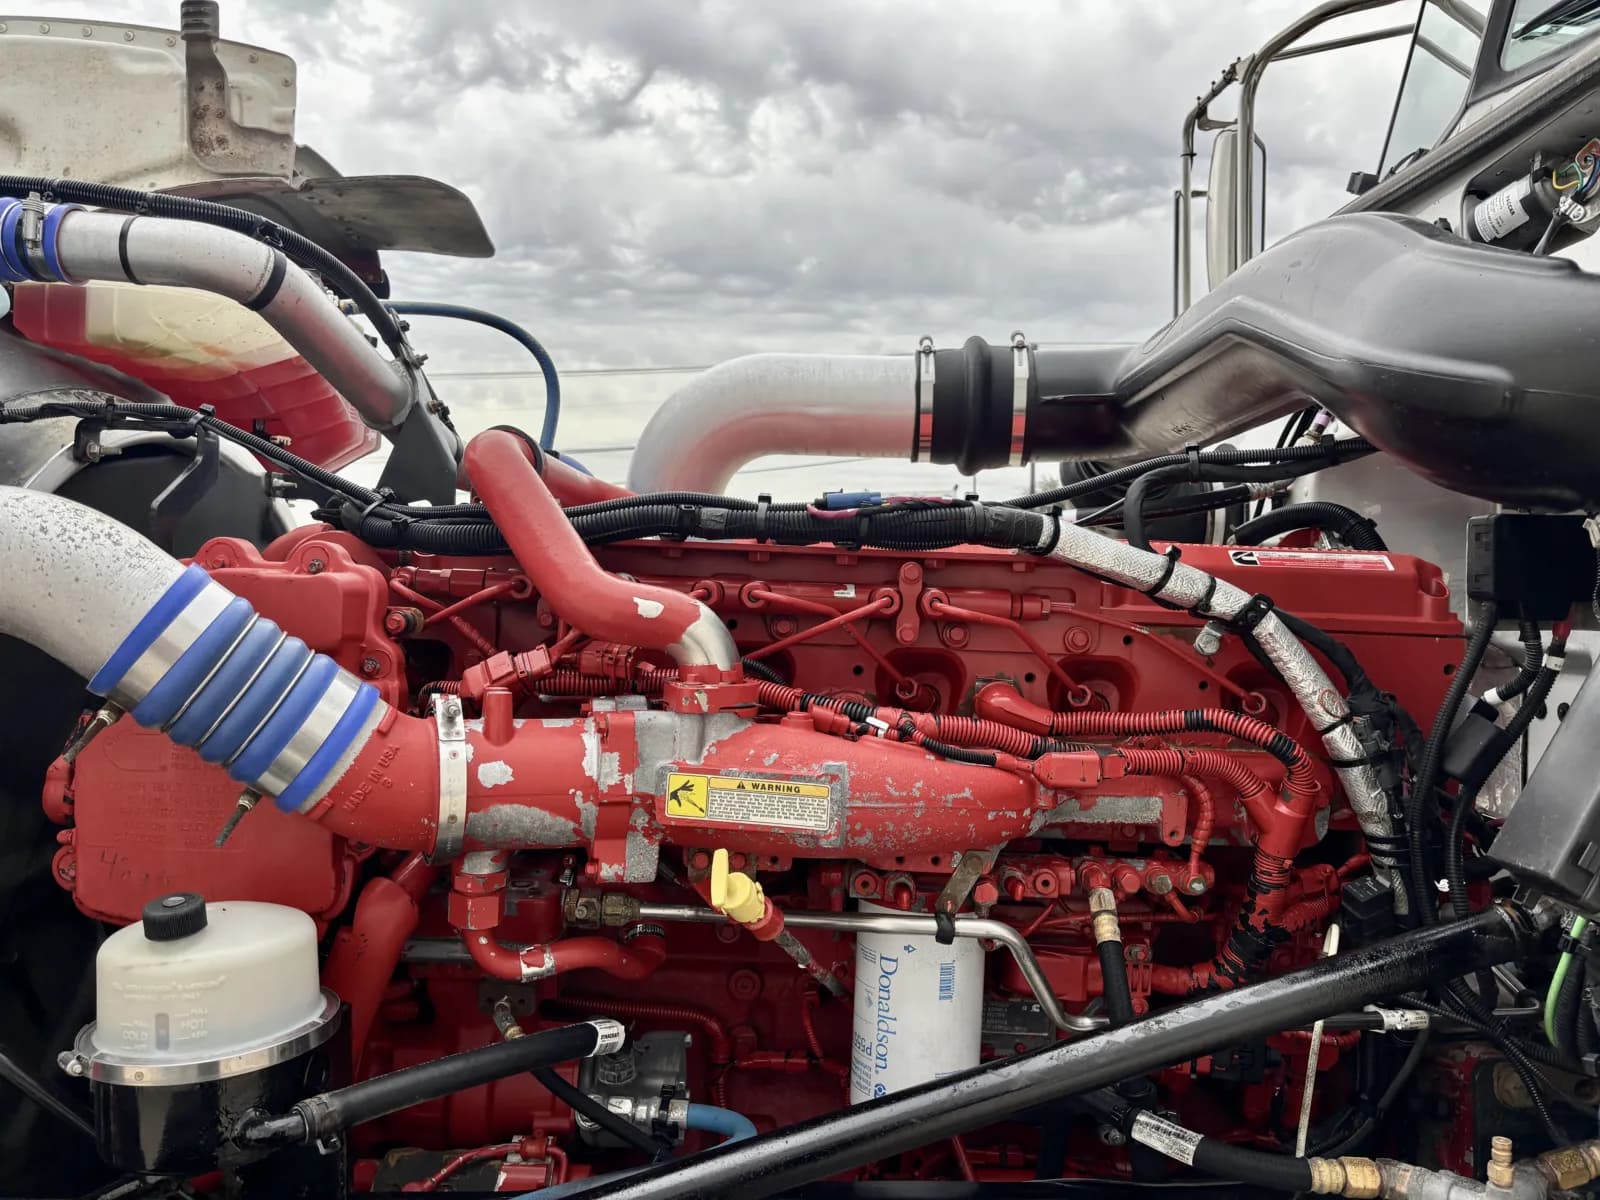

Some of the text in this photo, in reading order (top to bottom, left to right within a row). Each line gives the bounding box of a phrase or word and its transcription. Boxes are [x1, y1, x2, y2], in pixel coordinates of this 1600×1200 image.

[343, 744, 400, 812] MADE IN USA
[751, 782, 801, 793] WARNING
